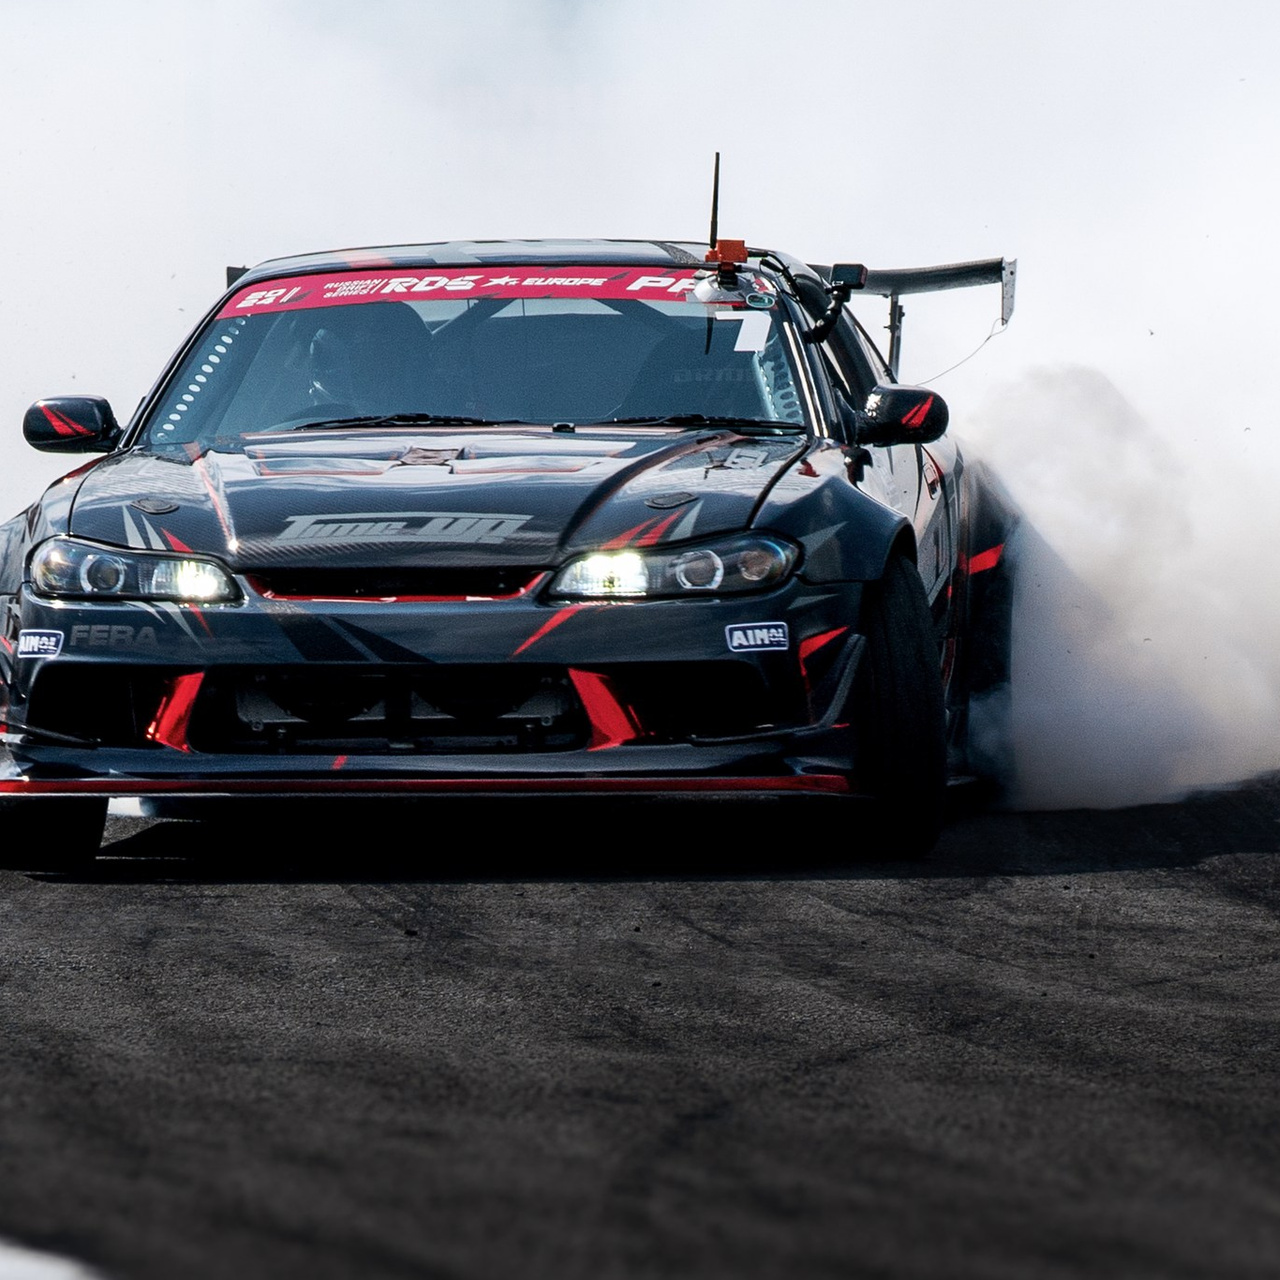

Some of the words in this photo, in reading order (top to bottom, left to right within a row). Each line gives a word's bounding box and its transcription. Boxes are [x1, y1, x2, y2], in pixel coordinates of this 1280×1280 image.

[380, 275, 484, 293] RDS
[521, 277, 608, 287] EUROPE
[70, 624, 158, 648] FERA
